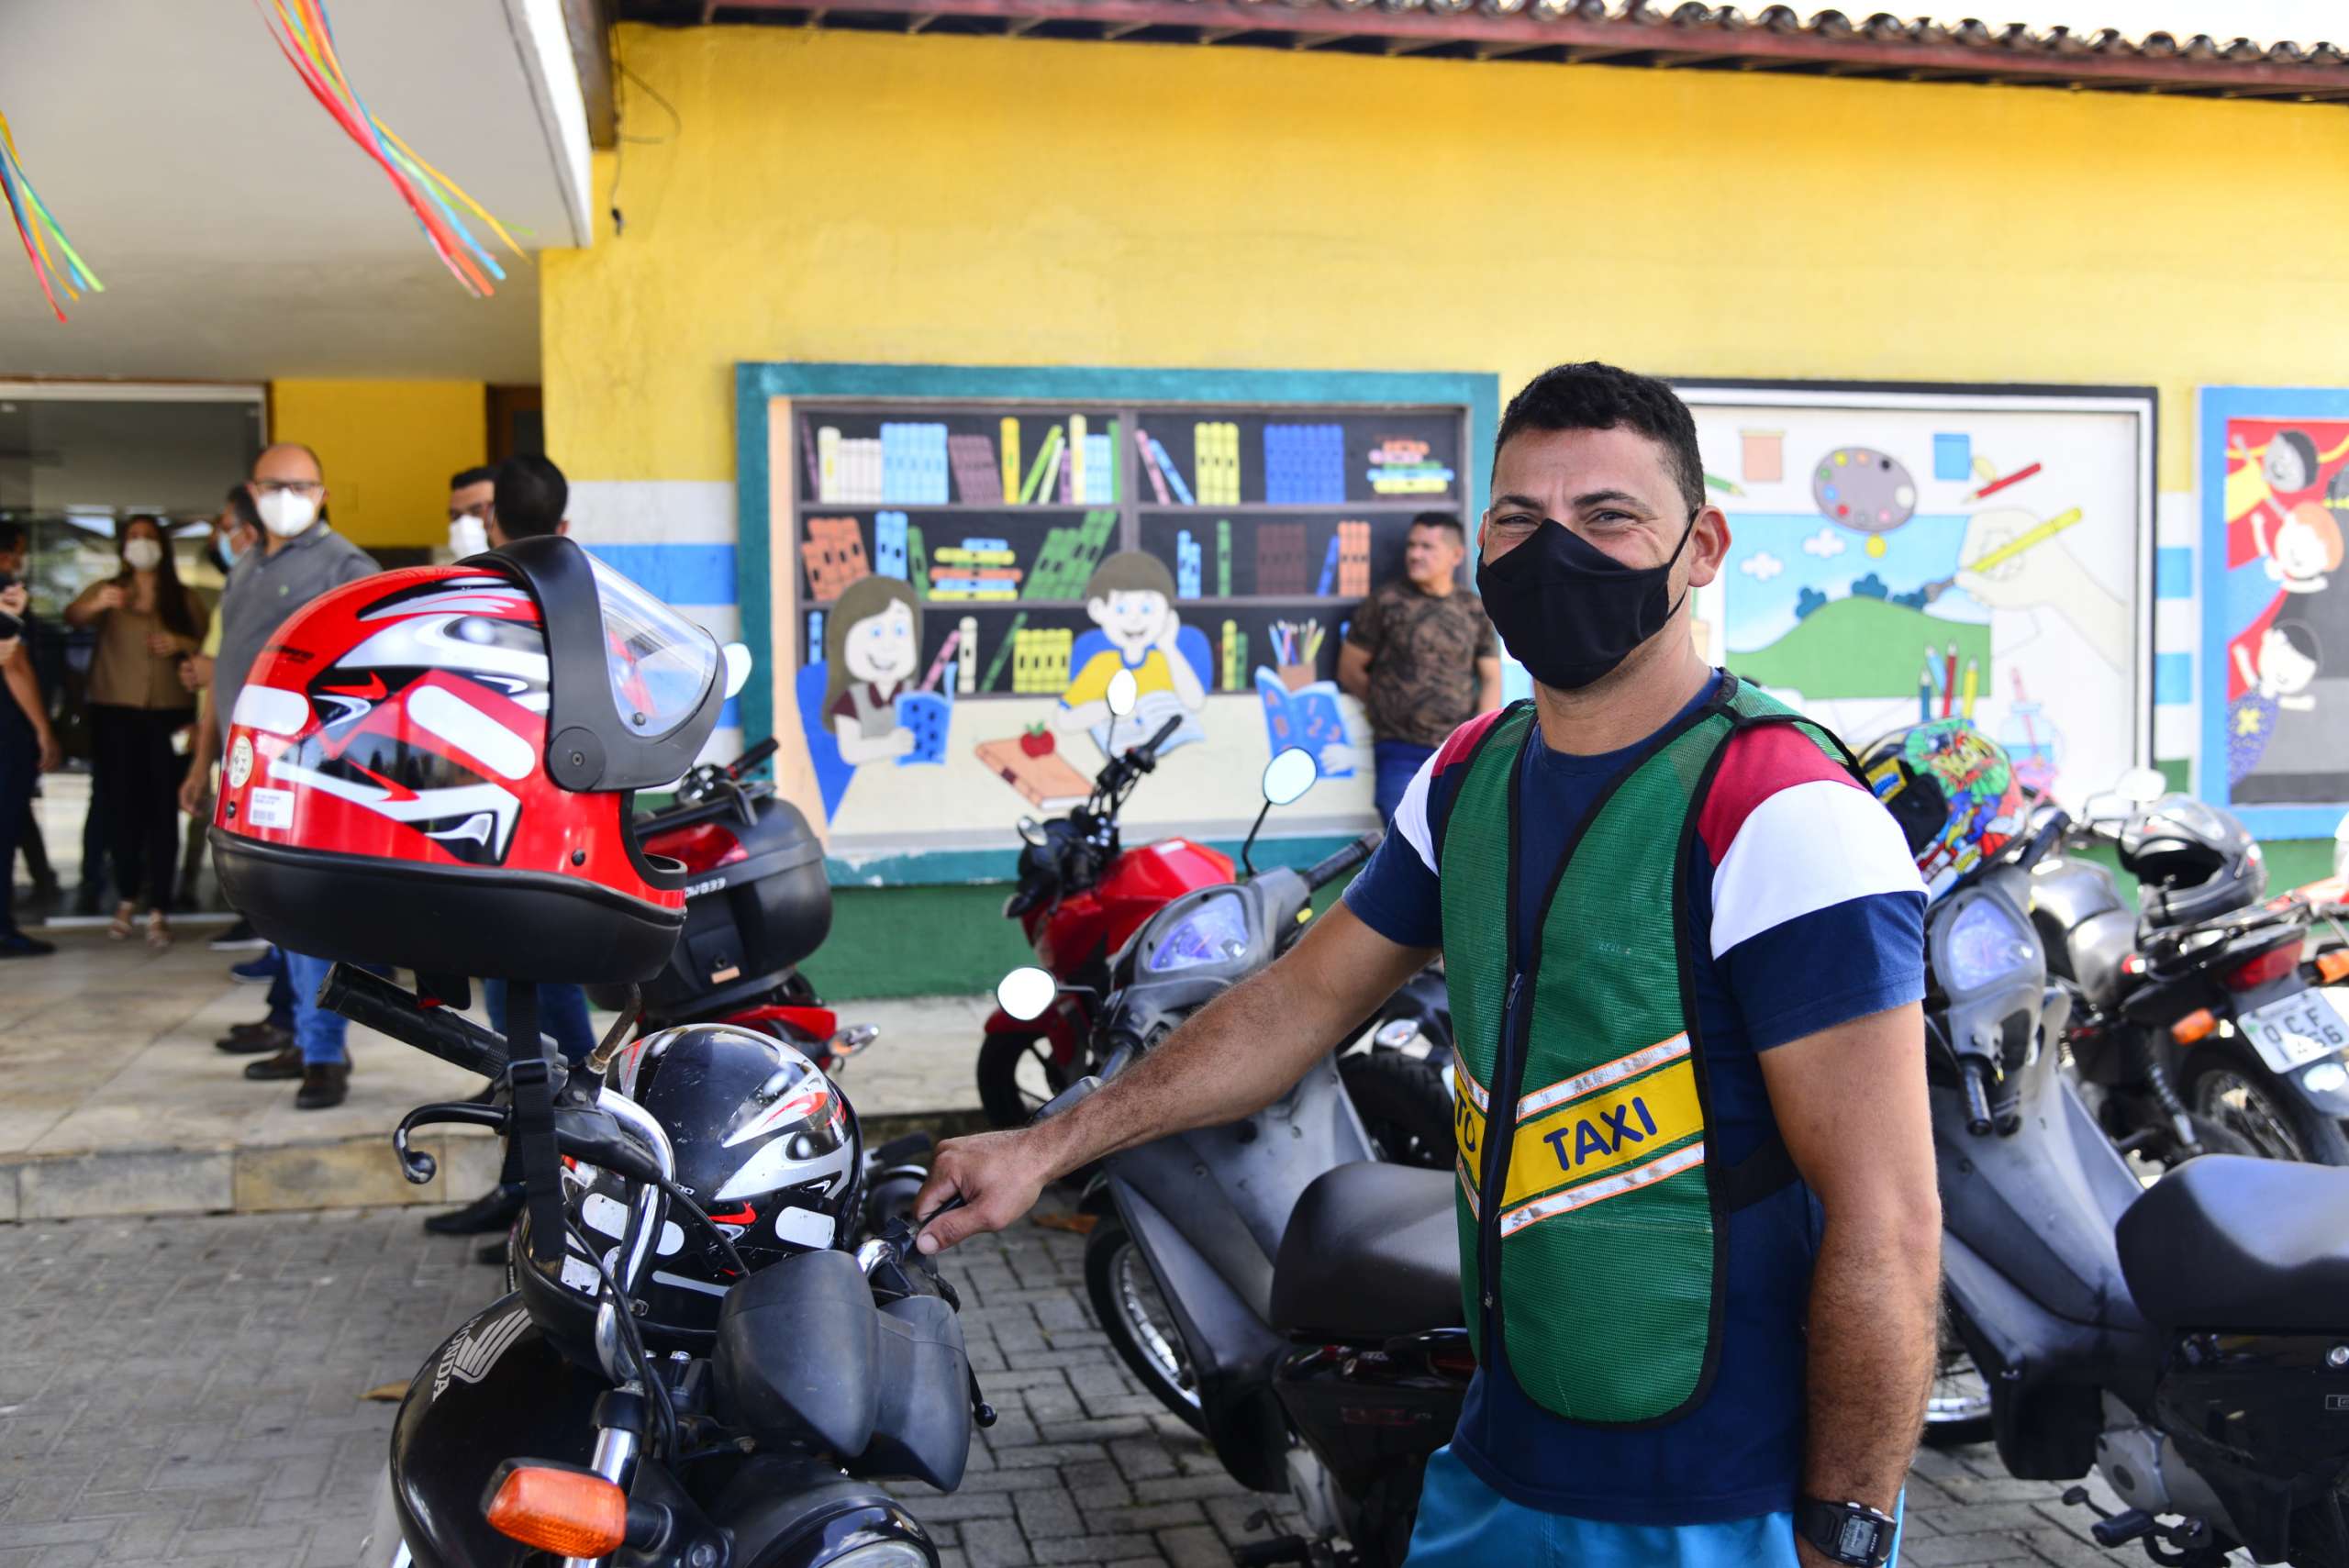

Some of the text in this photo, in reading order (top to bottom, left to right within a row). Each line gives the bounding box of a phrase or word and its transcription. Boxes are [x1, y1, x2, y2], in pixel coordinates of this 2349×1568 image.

[2263, 1006, 2321, 1044] OCF
[1543, 1096, 1657, 1172] TAXI
[432, 1313, 484, 1403] HONDA
